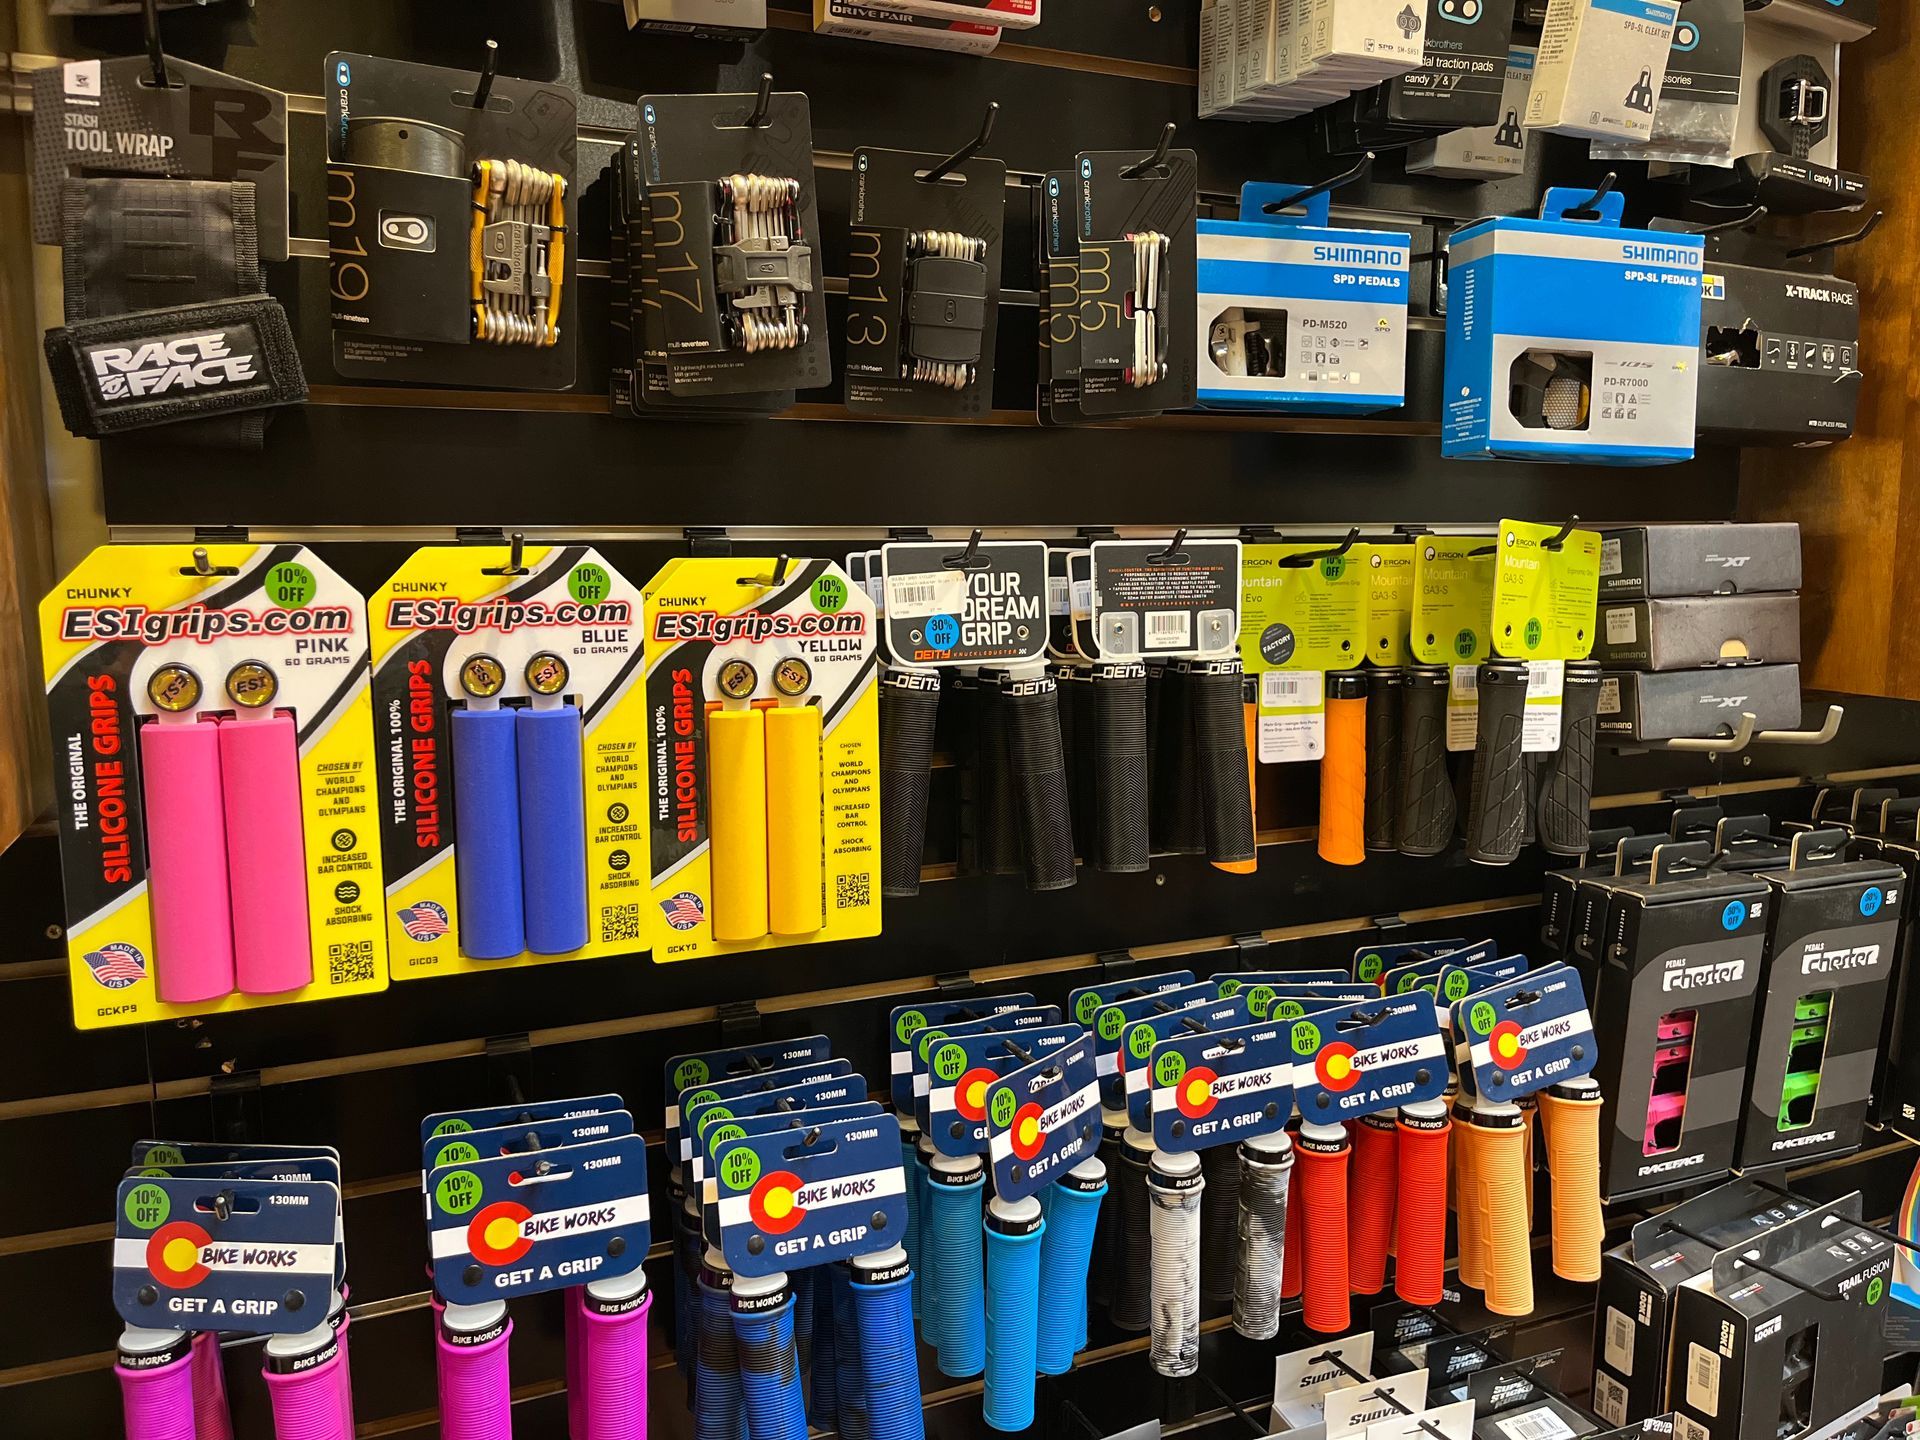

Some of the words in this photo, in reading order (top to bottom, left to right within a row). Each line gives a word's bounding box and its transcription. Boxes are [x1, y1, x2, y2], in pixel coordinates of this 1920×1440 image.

[831, 6, 876, 19] DRIVE
[879, 12, 914, 24] PAIR
[1645, 8, 1672, 20] SHIMANO
[1624, 20, 1644, 32] SPD-SL
[1645, 25, 1661, 36] CLEAT
[1662, 29, 1670, 39] SET
[1436, 57, 1469, 70] traction
[1471, 60, 1494, 72] pads
[1405, 75, 1430, 85] candy
[64, 113, 98, 128] STASH
[64, 127, 112, 153] TOOL
[116, 132, 173, 157] WRAP
[1814, 174, 1832, 187] candy
[858, 173, 866, 223] crankbrothers
[1083, 180, 1092, 236] crankbrothers
[1052, 198, 1060, 253] crankbrothers
[648, 191, 703, 314] m17
[1313, 246, 1402, 266] SHIMANO
[1622, 244, 1699, 266] SHIMANO
[1333, 274, 1355, 285] SPD
[1358, 275, 1400, 287] PEDALS
[1624, 270, 1659, 283] SPD-SL
[1661, 274, 1697, 287] PEDALS
[846, 232, 888, 345] m13
[1080, 247, 1121, 332] m5
[1785, 284, 1830, 302] X-TRACK
[1831, 291, 1853, 306] RACE
[1302, 319, 1348, 331] PD-M520
[90, 332, 232, 370] RACE
[127, 355, 257, 397] FACE
[1604, 376, 1649, 388] PD-R7000
[1516, 539, 1537, 548] ERGON
[1384, 558, 1410, 567] ERGON
[1438, 551, 1463, 560] ERGON
[1505, 555, 1540, 571] Mountain
[275, 567, 307, 585] 10%
[575, 568, 603, 583] 10%
[1423, 566, 1469, 581] Mountain
[392, 582, 447, 593] CHUNKY
[818, 580, 841, 592] 10%
[964, 572, 1020, 597] YOUR
[1608, 577, 1641, 587] SHIMANO
[67, 587, 132, 600] CHUNKY
[278, 586, 304, 602] OFF
[578, 585, 601, 600] OFF
[660, 597, 706, 607] CHUNKY
[820, 595, 839, 608] OFF
[963, 596, 1039, 621] DREAM
[388, 598, 630, 633] ESIgrips.com
[62, 605, 349, 643] ESIgrips.com
[655, 612, 864, 643] ESIgrips.com
[931, 619, 953, 631] 30%
[1527, 621, 1540, 633] 10%
[582, 629, 628, 643] BLUE
[935, 632, 951, 644] OFF
[961, 621, 1014, 646] GRIP.
[1528, 634, 1538, 645] OFF
[296, 637, 349, 654] PINK
[799, 639, 862, 652] YELLOW
[1263, 635, 1292, 655] FACTORY
[285, 656, 302, 666] 60
[306, 656, 350, 666] GRAMS
[914, 649, 951, 660] DEITY
[1610, 651, 1646, 660] SHIMANO
[1103, 663, 1147, 678] DEITY
[236, 676, 267, 695] ESI
[897, 675, 941, 691] DEITY
[1013, 681, 1058, 696] DEITY
[408, 660, 435, 733] GRIPS
[672, 669, 695, 735] GRIPS
[88, 673, 122, 754] GRIPS
[391, 699, 401, 733] 100%
[657, 706, 666, 733] 100%
[1600, 722, 1632, 730] SHIMANO
[68, 733, 87, 800] ORIGINAL
[317, 763, 348, 773] CHOSEN
[350, 761, 363, 771] BY
[391, 735, 405, 798] ORIGINAL
[657, 738, 669, 796] ORIGINAL
[325, 776, 355, 786] WORLD
[316, 785, 366, 797] CHAMPIONS
[412, 738, 439, 848] SILICONE
[674, 741, 698, 843] SILICONE
[333, 796, 350, 805] AND
[659, 796, 669, 820] THE
[75, 803, 90, 830] THE
[319, 805, 366, 817] OLYMPIANS
[395, 800, 406, 824] THE
[96, 761, 133, 884] SILICONE
[322, 852, 367, 864] INCREASED
[318, 864, 334, 874] BAR
[336, 861, 373, 873] CONTROL
[335, 906, 362, 916] SHOCK
[326, 913, 373, 926] ABSORBING
[110, 944, 134, 954] MADE
[1804, 943, 1825, 953] PEDALS
[1665, 957, 1686, 968] PEDALS
[108, 978, 132, 988] USA
[1543, 981, 1566, 994] 130MM
[97, 1004, 137, 1017] GCKP9
[1474, 1005, 1491, 1018] 10%
[1293, 1024, 1314, 1038] 10%
[1478, 1017, 1491, 1030] OFF
[1251, 1031, 1276, 1042] 130MM
[1519, 1030, 1539, 1046] BIKE
[1541, 1020, 1571, 1040] WORKS
[1298, 1037, 1315, 1051] OFF
[1066, 1051, 1085, 1066] 130MM
[1161, 1055, 1180, 1069] 10%
[1353, 1052, 1377, 1068] BIKE
[1380, 1043, 1419, 1062] WORKS
[1164, 1069, 1180, 1082] OFF
[1510, 1070, 1533, 1086] GET
[1535, 1068, 1544, 1080] A
[1545, 1057, 1571, 1077] GRIP
[1212, 1075, 1236, 1096] BIKE
[1238, 1073, 1272, 1090] WORKS
[995, 1091, 1011, 1107] 10%
[1339, 1092, 1366, 1109] GET
[1368, 1090, 1380, 1102] A
[1382, 1082, 1416, 1099] GRIP
[998, 1107, 1011, 1122] OFF
[1040, 1111, 1059, 1130] BIKE
[1060, 1095, 1085, 1120] WORKS
[1192, 1120, 1218, 1136] GET
[1221, 1118, 1231, 1130] A
[1232, 1111, 1263, 1128] GRIP
[845, 1129, 878, 1142] 130MM
[1771, 1130, 1836, 1151] RACEFACE
[583, 1156, 621, 1171] 130MM
[728, 1152, 753, 1168] 10%
[1028, 1159, 1050, 1179] GET
[1051, 1152, 1059, 1165] A
[1060, 1138, 1083, 1160] GRIP
[1638, 1153, 1704, 1177] RACEFACE
[444, 1175, 473, 1192] 10%
[731, 1169, 752, 1184] OFF
[134, 1190, 162, 1205] 10%
[797, 1187, 828, 1205] BIKE
[831, 1178, 876, 1197] WORKS
[269, 1195, 309, 1206] 130MM
[449, 1192, 472, 1209] OFF
[136, 1207, 160, 1223] OFF
[524, 1218, 559, 1236] BIKE
[564, 1207, 616, 1229] WORKS
[774, 1236, 808, 1256] GET
[812, 1234, 825, 1249] A
[828, 1226, 867, 1246] GRIP
[201, 1248, 239, 1265] BIKE
[242, 1250, 298, 1267] WORKS
[494, 1269, 534, 1288] GET
[539, 1266, 553, 1279] A
[558, 1256, 604, 1276] GRIP
[1837, 1273, 1862, 1292] TRAIL
[1862, 1258, 1890, 1279] FUSION
[168, 1297, 207, 1313] GET
[211, 1299, 226, 1314] A
[231, 1299, 278, 1315] GRIP
[1754, 1325, 1775, 1343] LOOK
